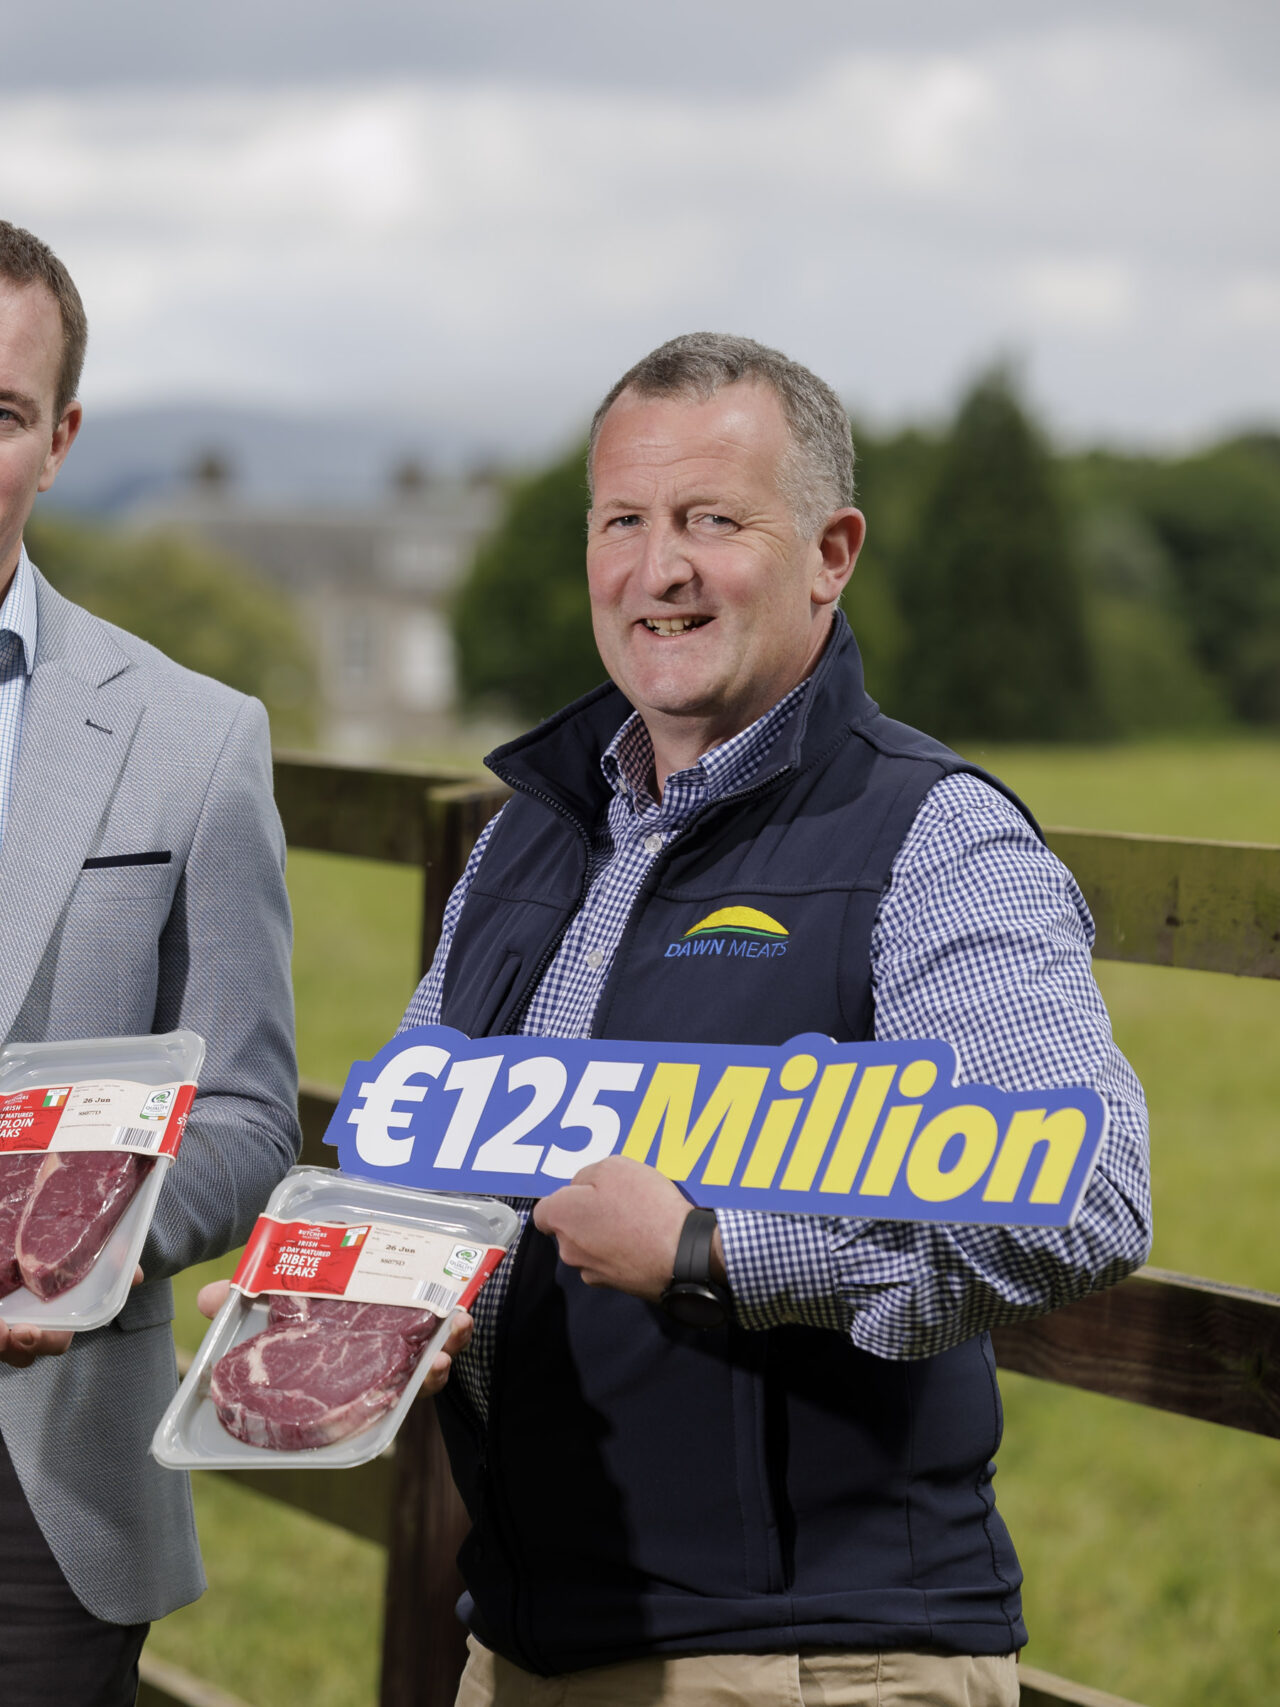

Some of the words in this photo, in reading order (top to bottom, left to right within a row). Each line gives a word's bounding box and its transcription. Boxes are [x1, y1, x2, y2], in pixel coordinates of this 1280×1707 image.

[664, 939, 726, 958] DAWN
[726, 939, 790, 958] MEATS
[2, 1104, 22, 1112] IRISH
[298, 1240, 318, 1248] IRISH
[300, 1248, 331, 1257] MATURED
[279, 1253, 322, 1267] RIBEYE
[273, 1265, 318, 1278] STEAKS
